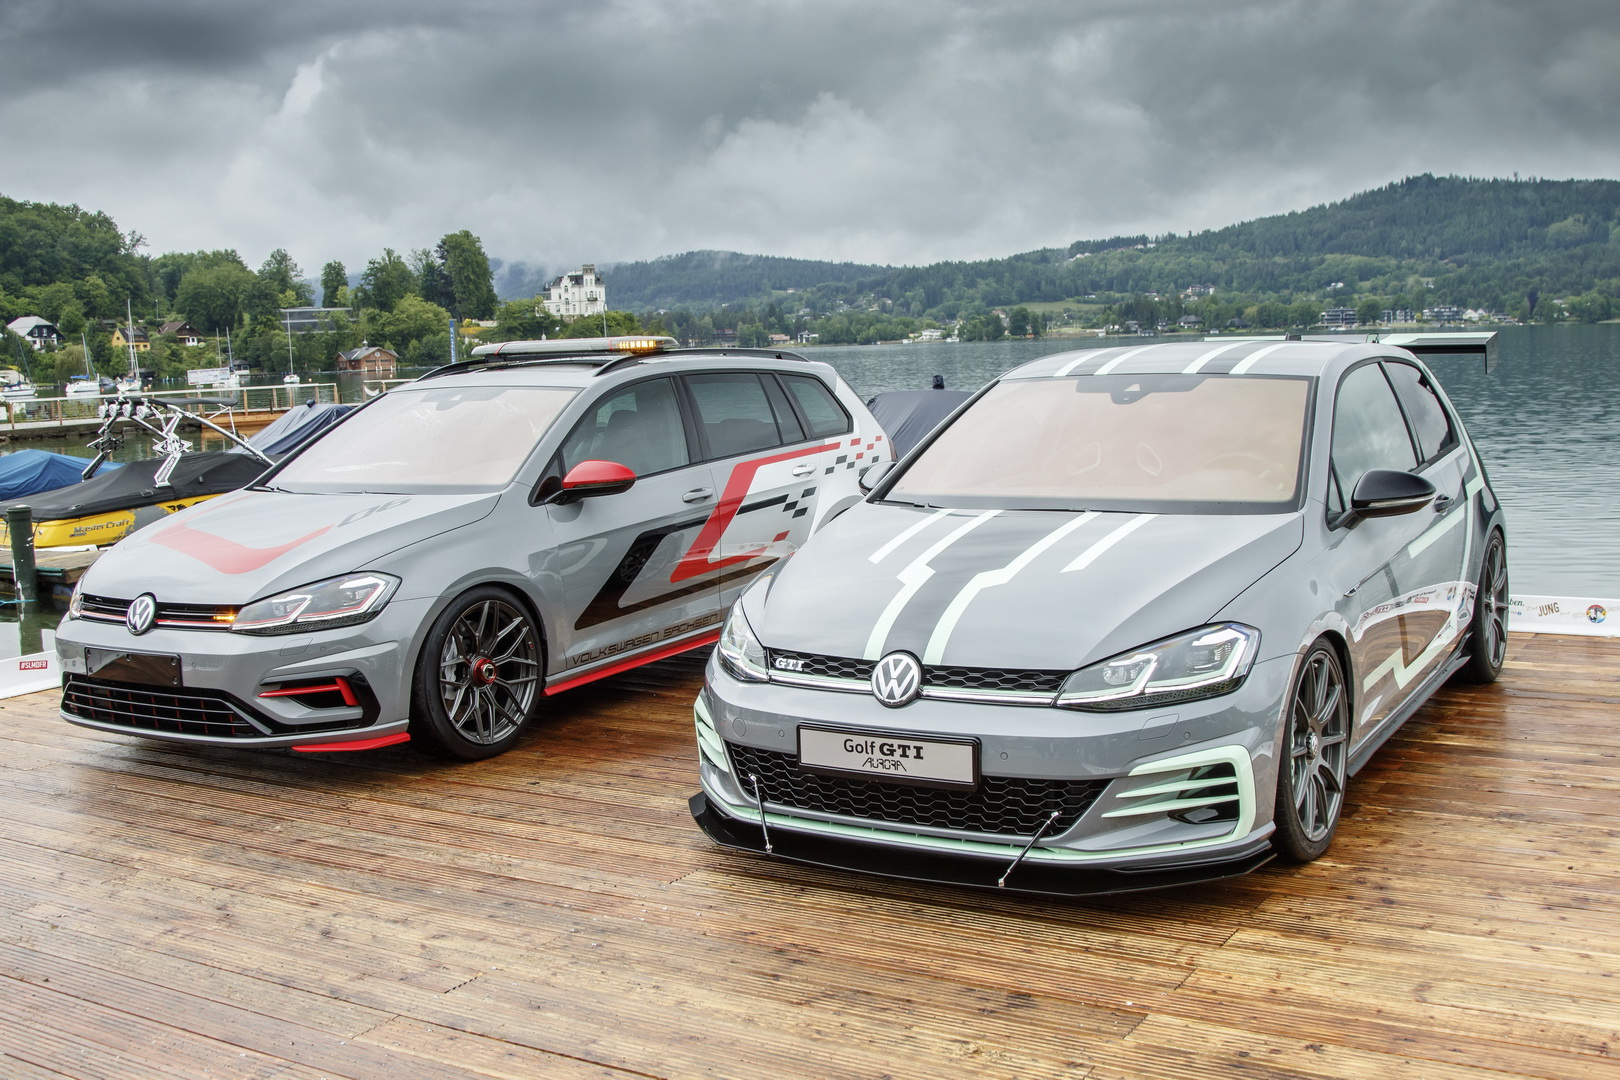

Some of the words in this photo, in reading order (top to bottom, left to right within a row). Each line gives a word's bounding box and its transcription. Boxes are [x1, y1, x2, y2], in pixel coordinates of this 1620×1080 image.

[74, 519, 130, 534] MasterCraft
[1538, 602, 1560, 617] JUNG
[572, 632, 660, 665] VOLKSWAGEN
[663, 613, 718, 638] SACHSEN
[775, 657, 805, 671] GTI
[843, 738, 876, 755] Golf
[879, 742, 924, 760] GTI
[862, 757, 908, 772] AURORA
